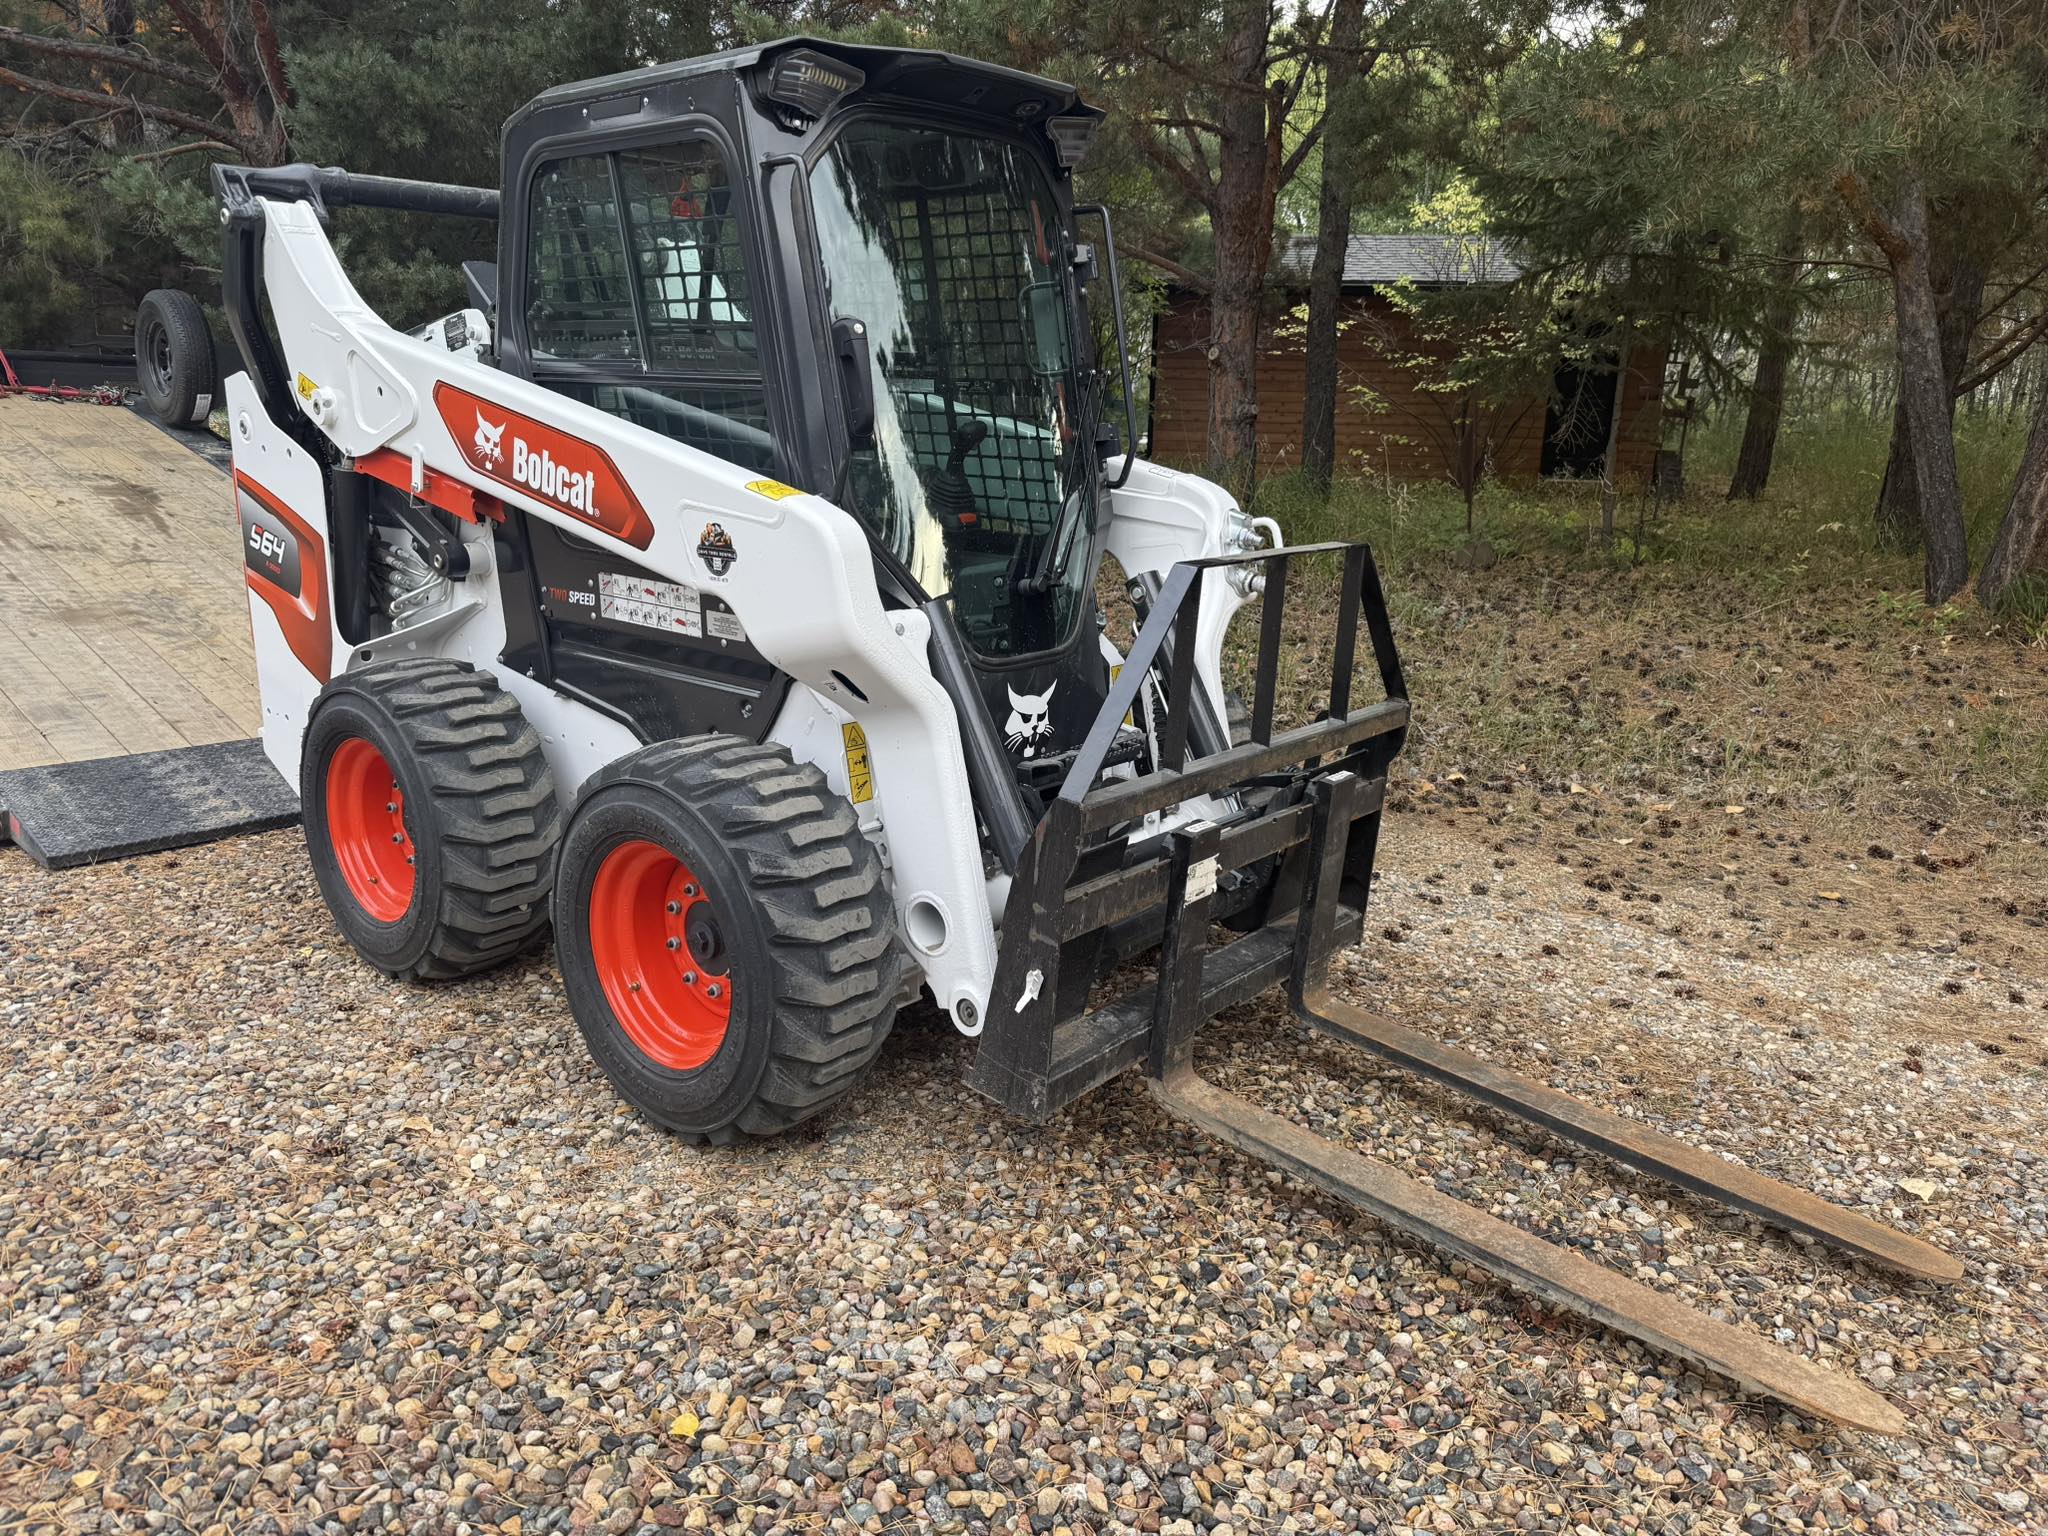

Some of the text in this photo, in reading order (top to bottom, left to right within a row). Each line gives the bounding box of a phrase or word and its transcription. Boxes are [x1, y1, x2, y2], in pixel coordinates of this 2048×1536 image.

[512, 436, 596, 516] Bobcat
[249, 523, 286, 565] S64
[549, 587, 596, 607] TWO SPEED
